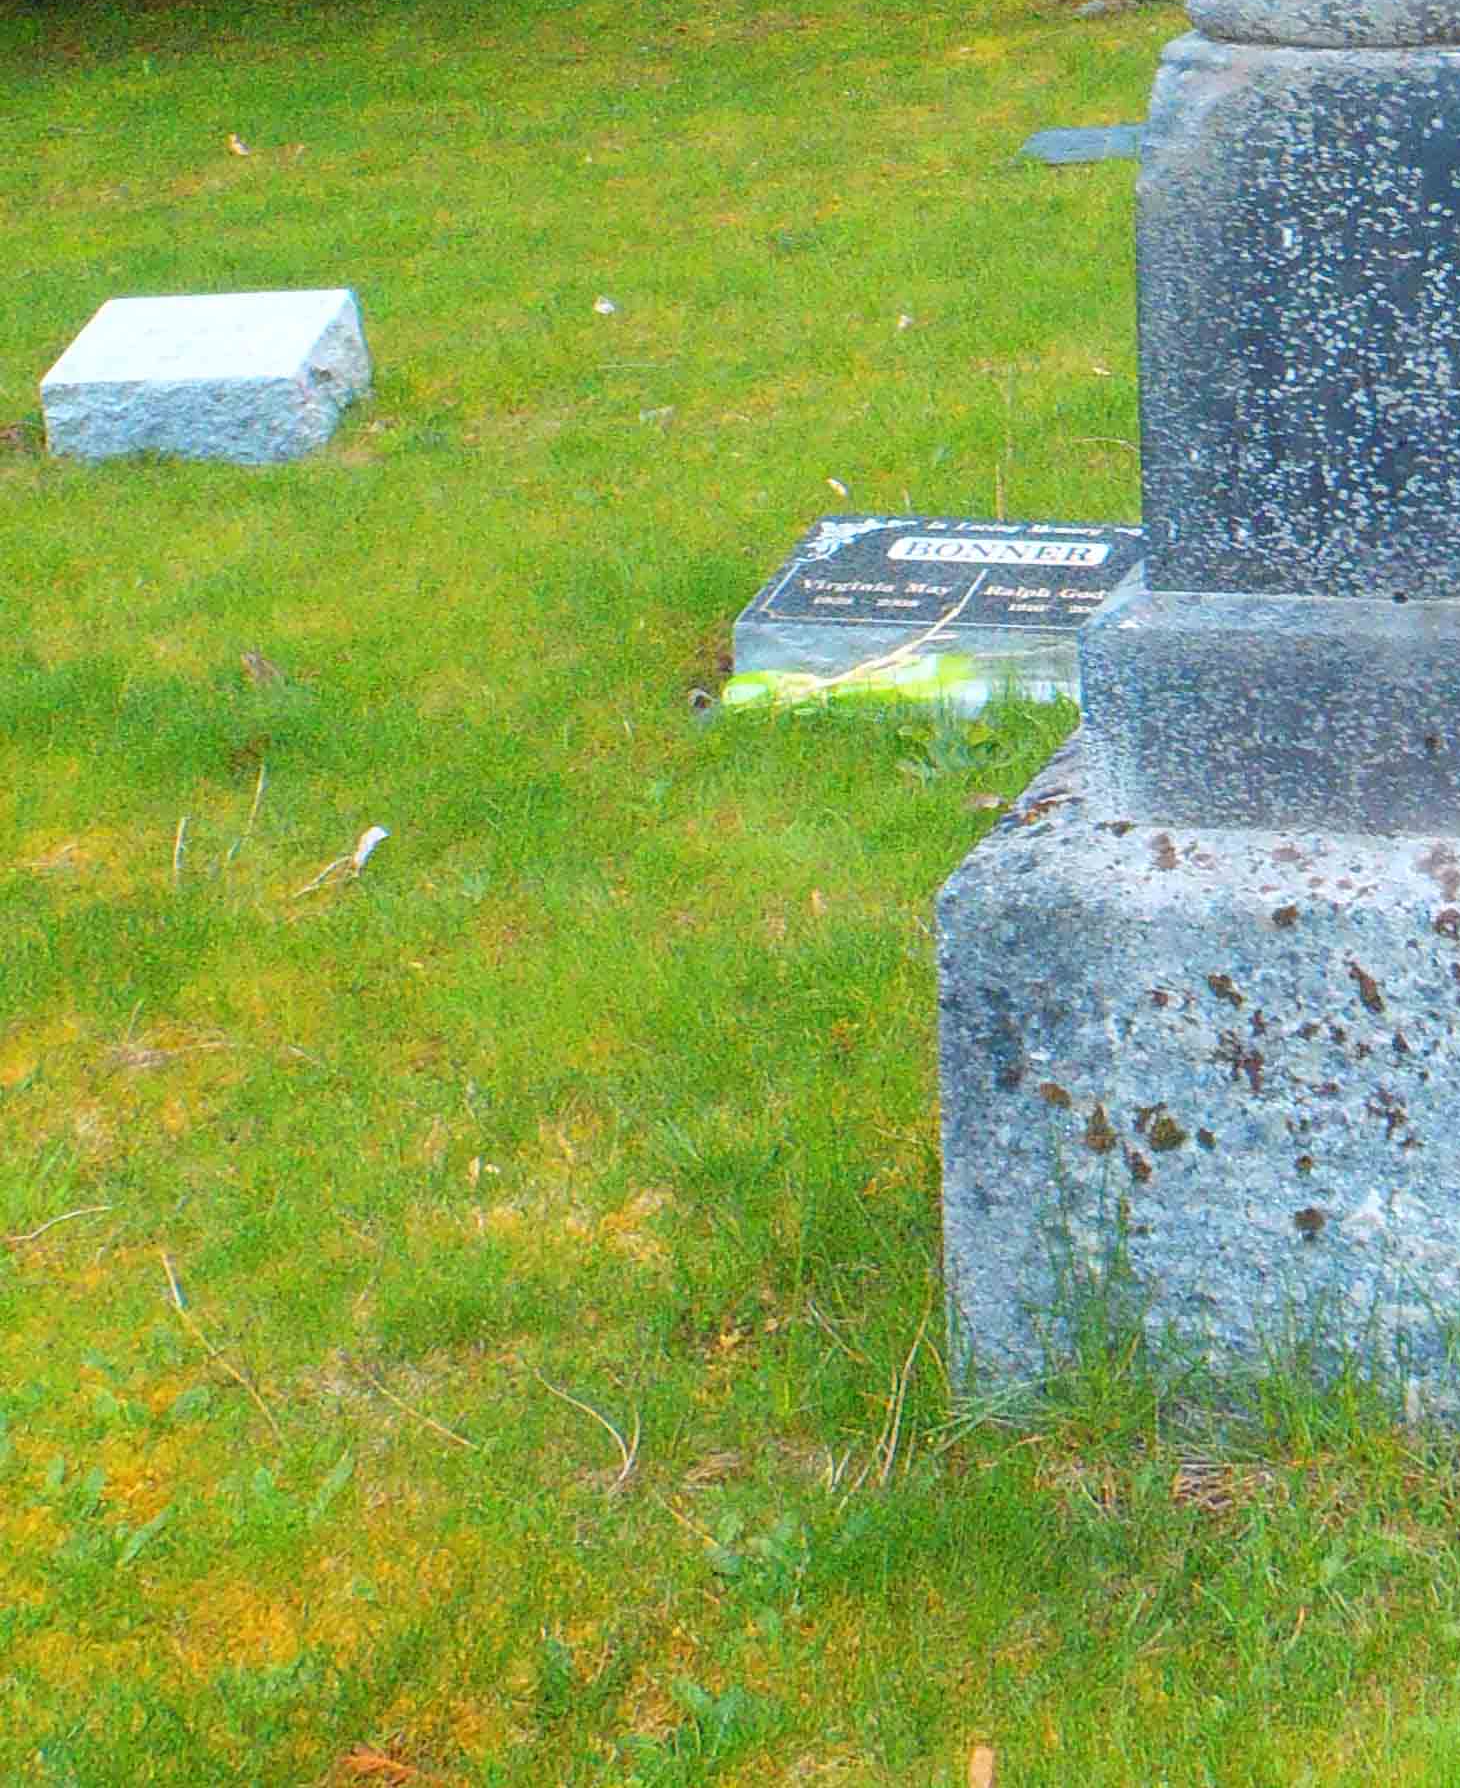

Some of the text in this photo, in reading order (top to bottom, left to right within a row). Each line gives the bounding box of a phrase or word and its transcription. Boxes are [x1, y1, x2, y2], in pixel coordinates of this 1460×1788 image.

[905, 542, 1093, 562] BONNER
[802, 580, 952, 595] Virginia May
[983, 586, 1050, 598] Ralph
